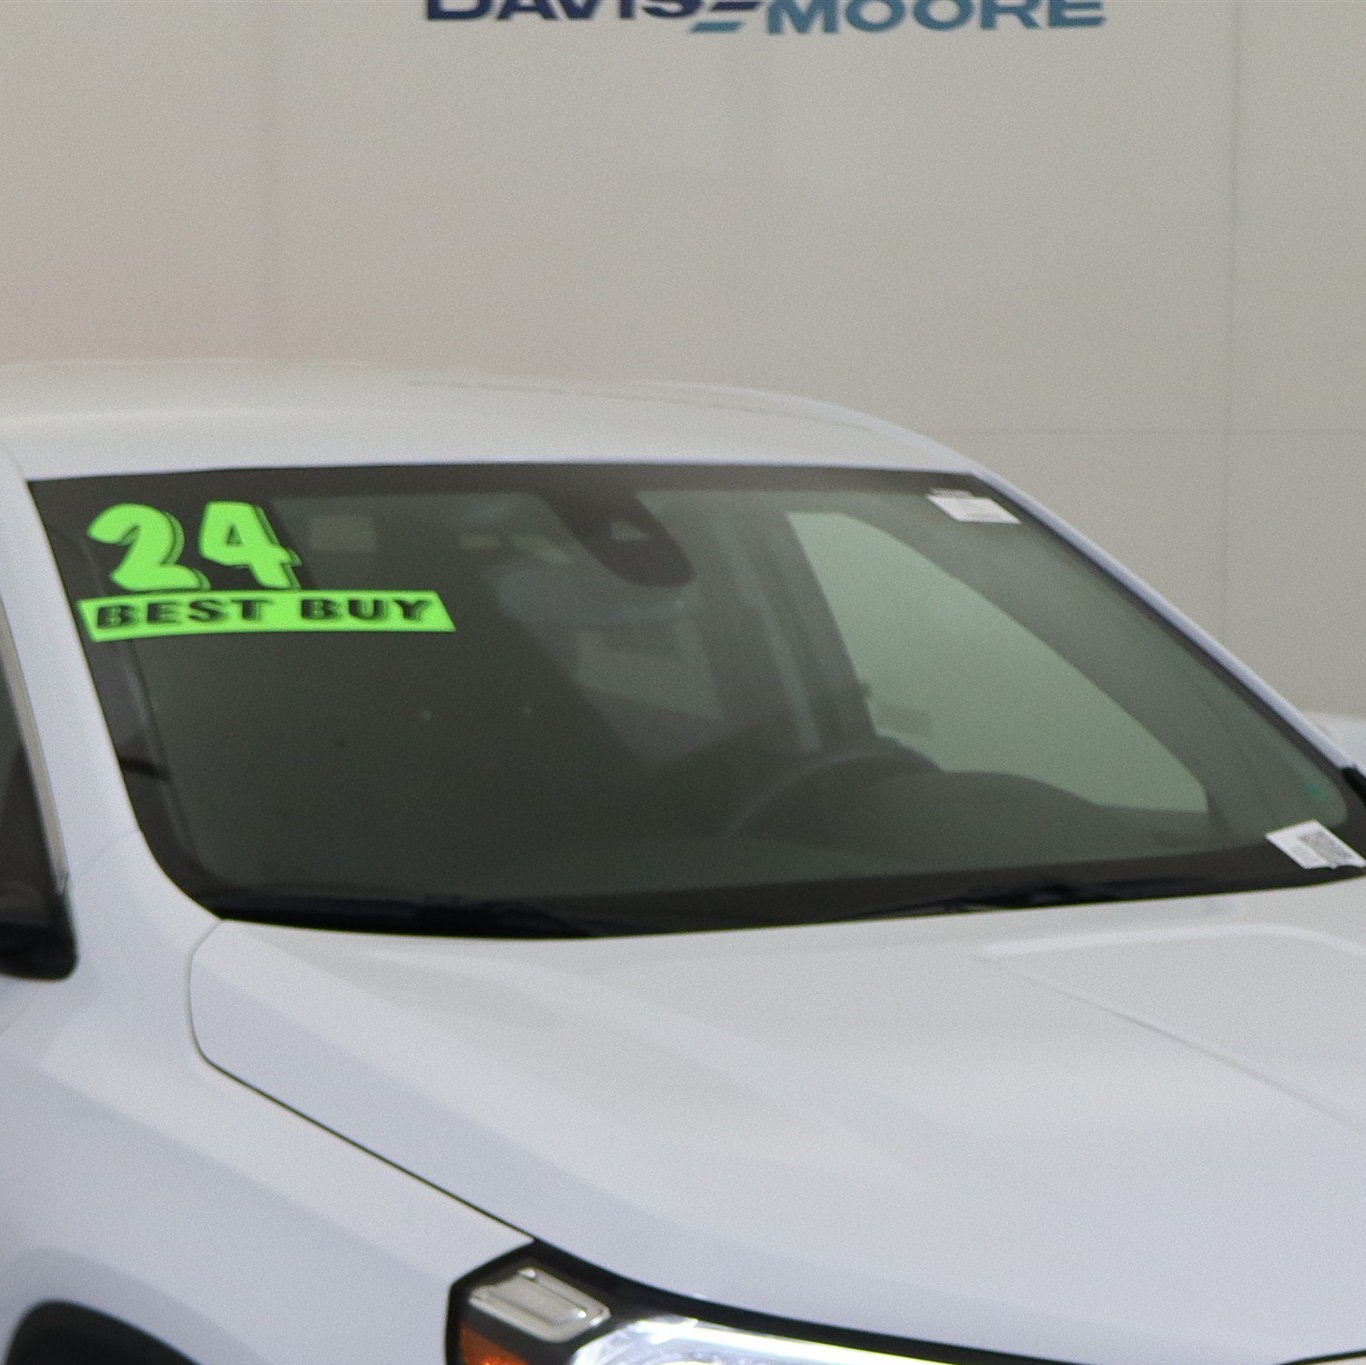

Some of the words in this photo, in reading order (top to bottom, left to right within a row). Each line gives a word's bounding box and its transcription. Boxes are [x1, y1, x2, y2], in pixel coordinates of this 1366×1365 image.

[766, 0, 1107, 35] MOORE
[86, 501, 302, 591] 24
[96, 597, 273, 630] BEST
[300, 598, 431, 622] BUY
